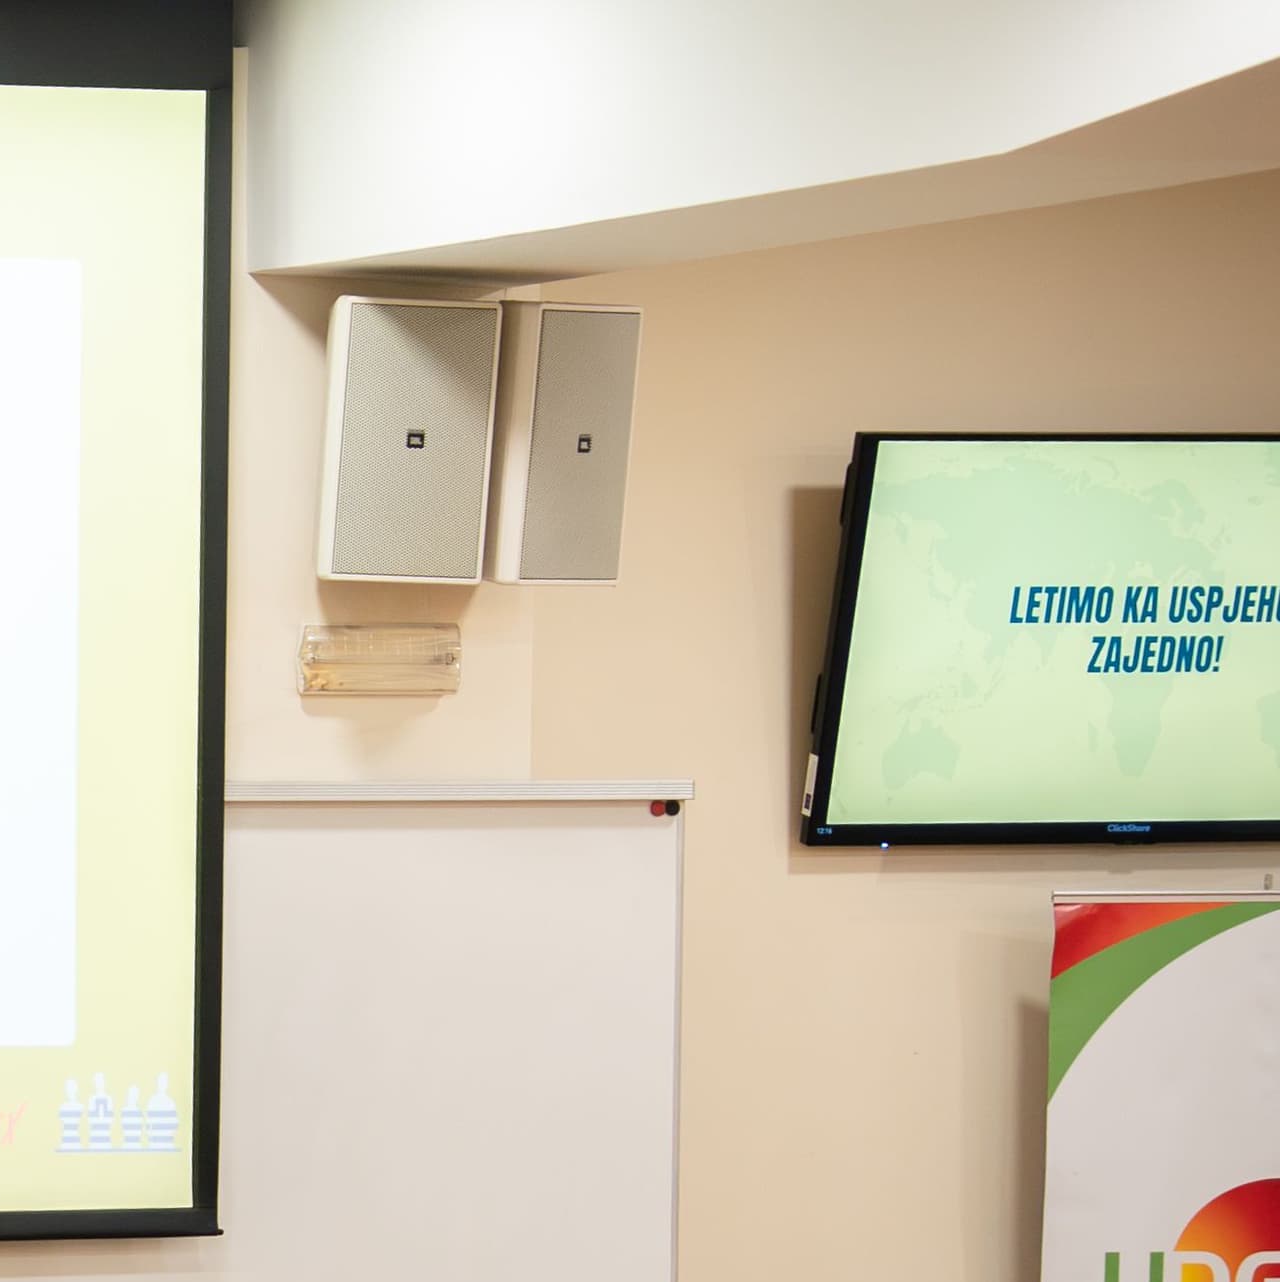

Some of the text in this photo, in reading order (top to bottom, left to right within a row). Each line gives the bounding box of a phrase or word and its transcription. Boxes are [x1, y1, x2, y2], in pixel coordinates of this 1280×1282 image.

[1008, 586, 1280, 624] LETIMO KA USPJEH
[1086, 635, 1225, 673] ZAJEDNO!
